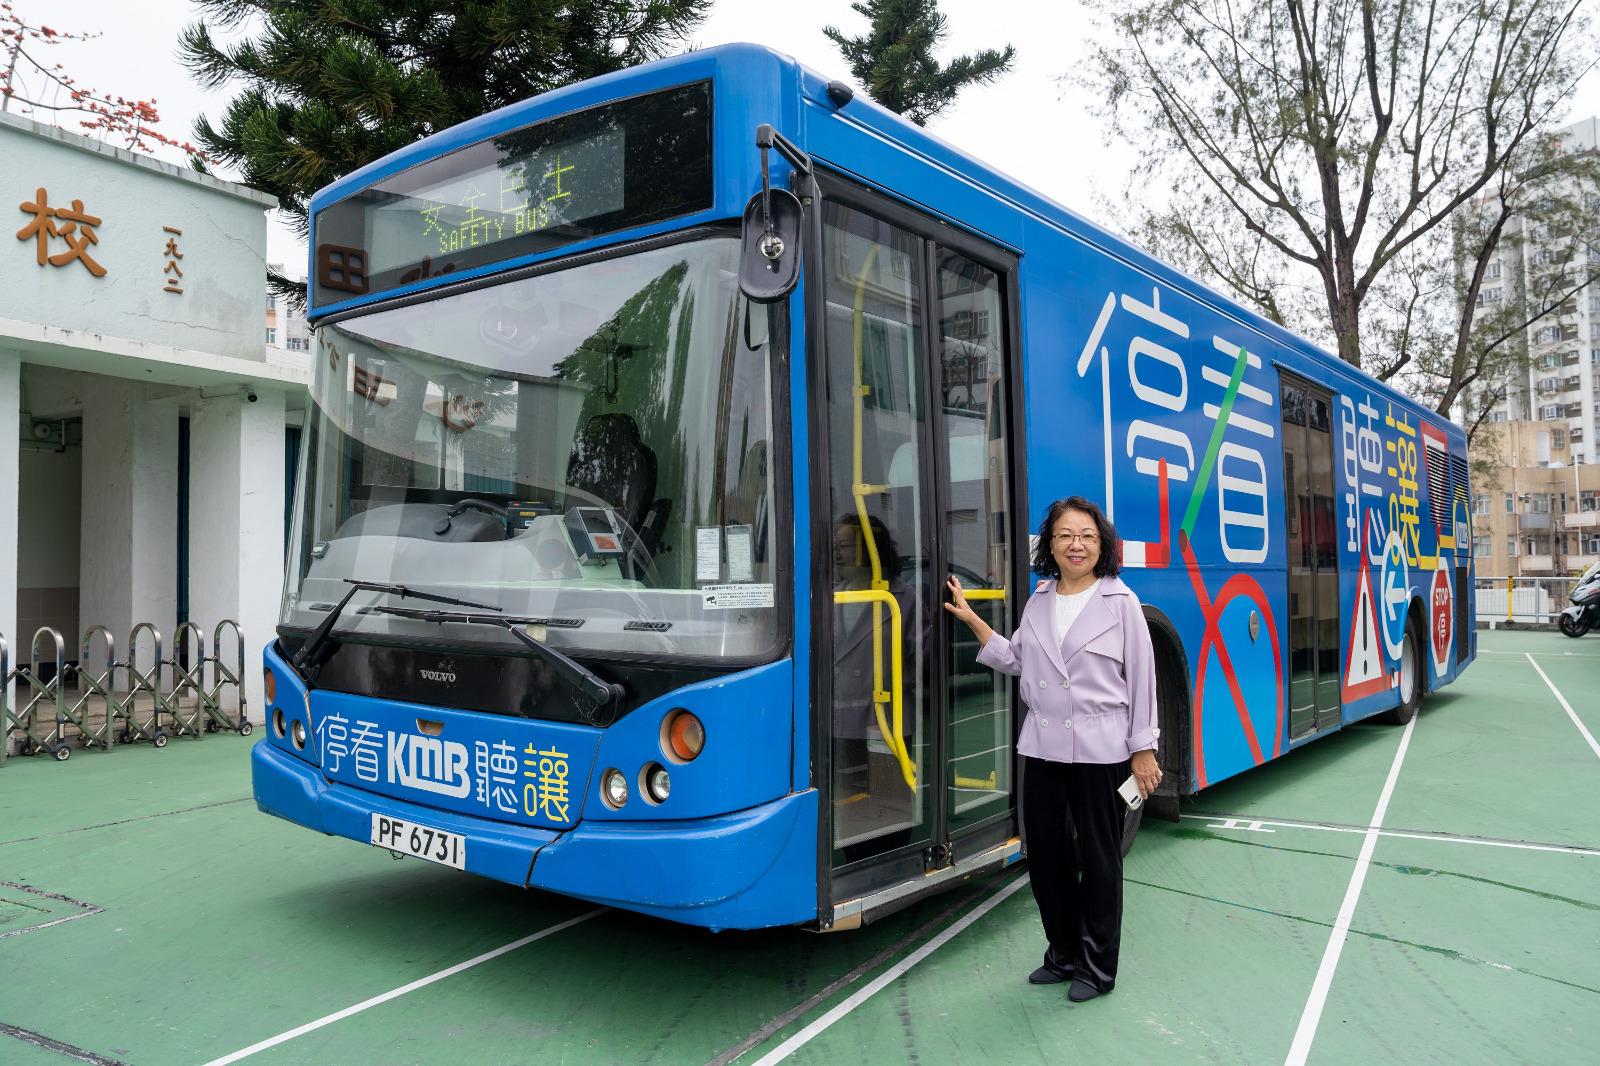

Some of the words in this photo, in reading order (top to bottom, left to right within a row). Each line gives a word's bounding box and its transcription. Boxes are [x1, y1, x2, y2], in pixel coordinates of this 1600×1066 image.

[16, 187, 108, 277] 校
[439, 216, 505, 254] SAFETY
[515, 204, 549, 235] BUS
[163, 225, 184, 295] 一九八二
[1435, 587, 1448, 607] STOP
[1437, 610, 1447, 650] 停
[419, 669, 457, 683] VOLVO
[378, 817, 404, 847] PF
[410, 826, 458, 864] 6731
